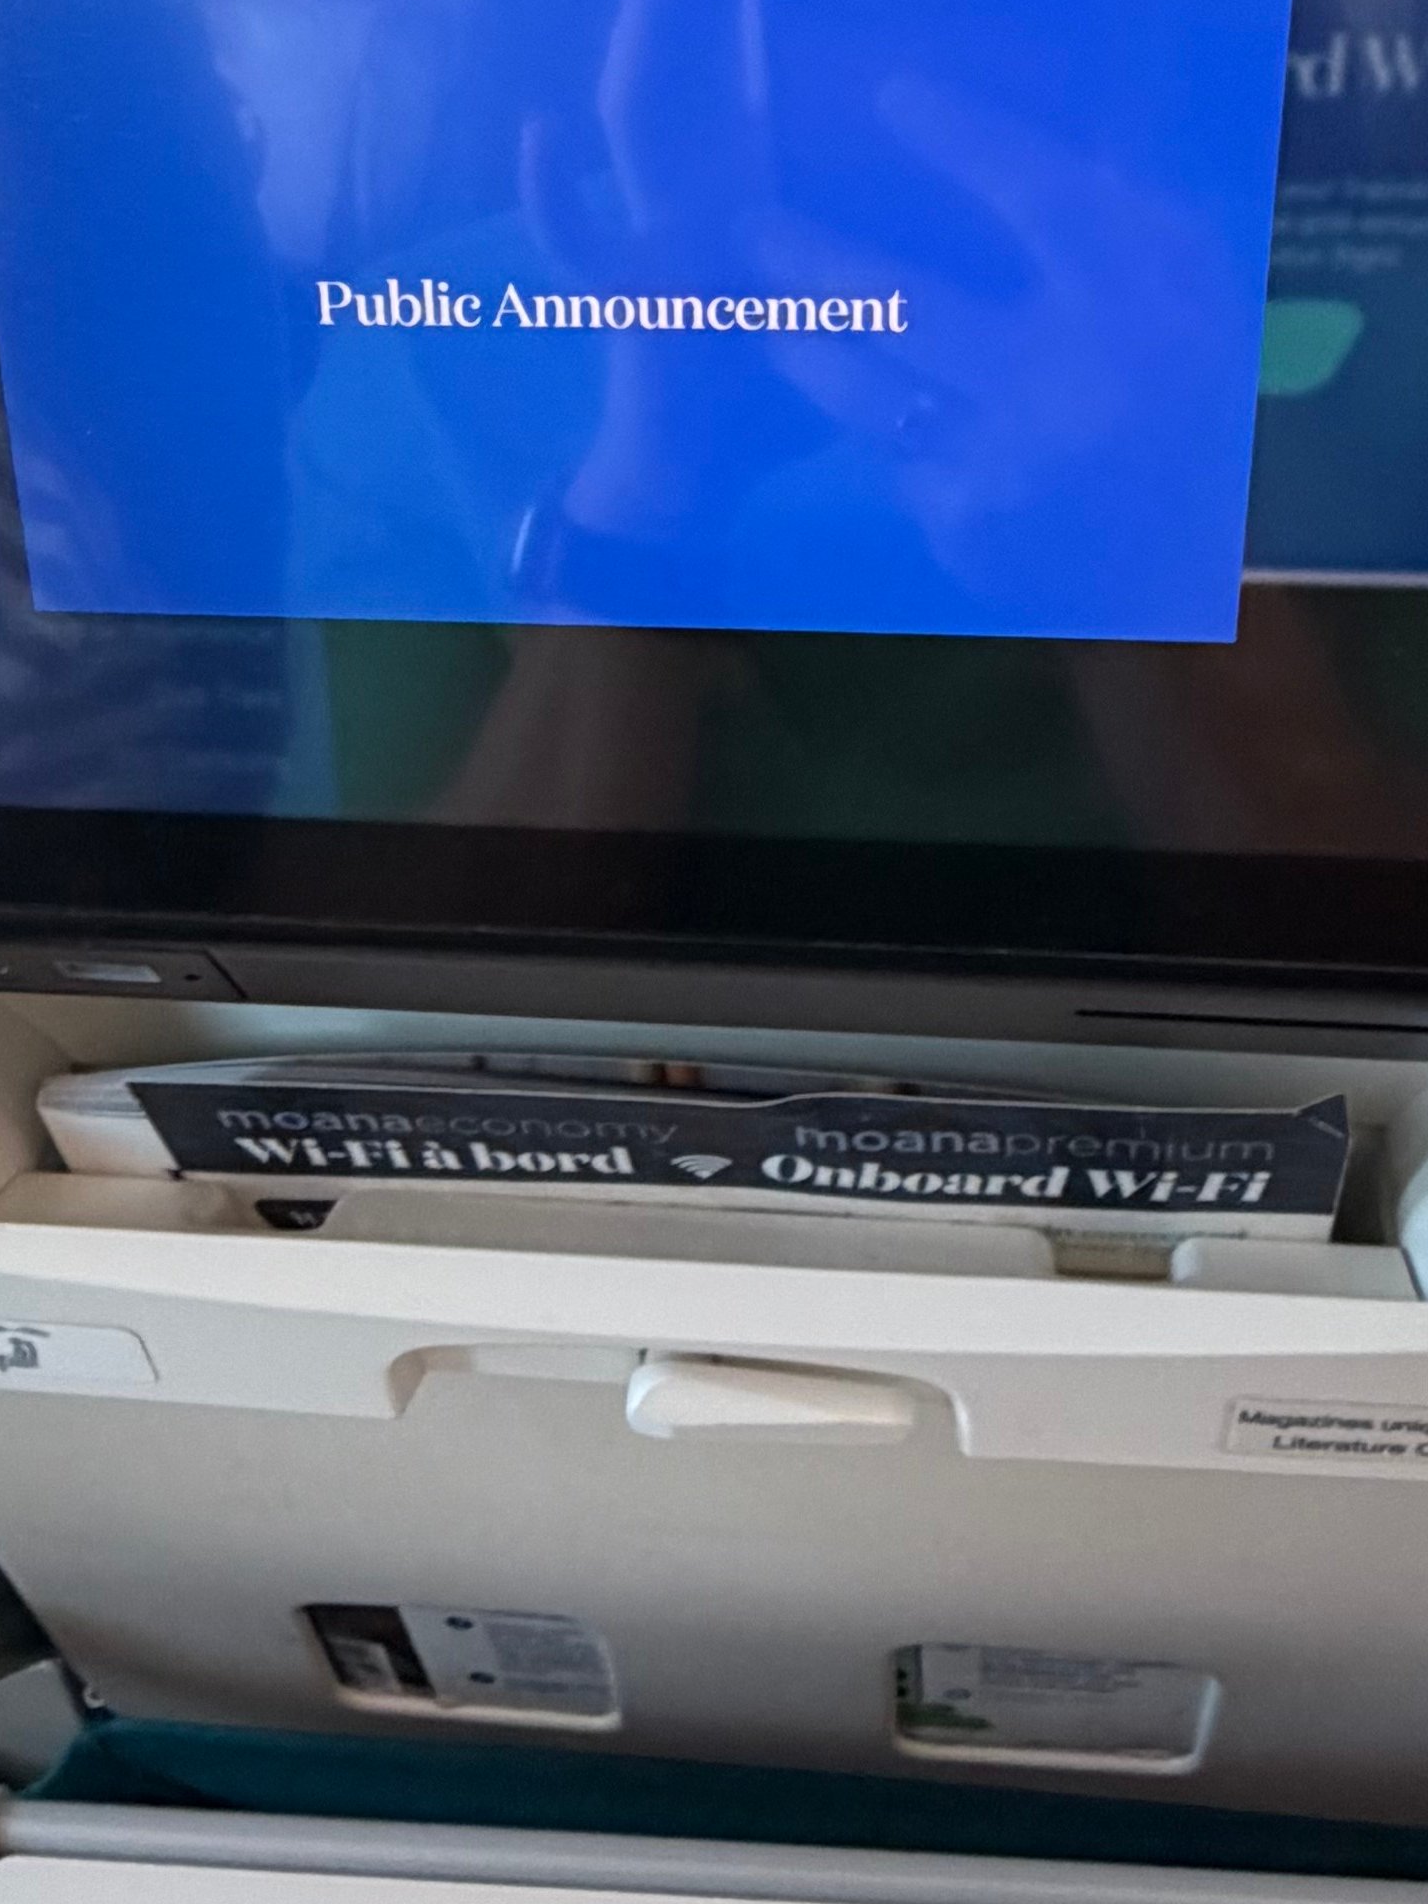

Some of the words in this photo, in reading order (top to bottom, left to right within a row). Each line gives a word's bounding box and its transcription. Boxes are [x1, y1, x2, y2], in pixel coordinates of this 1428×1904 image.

[316, 279, 481, 328] Public
[493, 282, 909, 332] Announcement
[235, 1137, 412, 1170] Wi-Fi
[424, 1139, 460, 1171] à
[471, 1142, 636, 1175] bord
[761, 1153, 1070, 1198] Onboard
[1086, 1169, 1272, 1203] Wi-Fi
[1272, 1435, 1407, 1455] Literature
